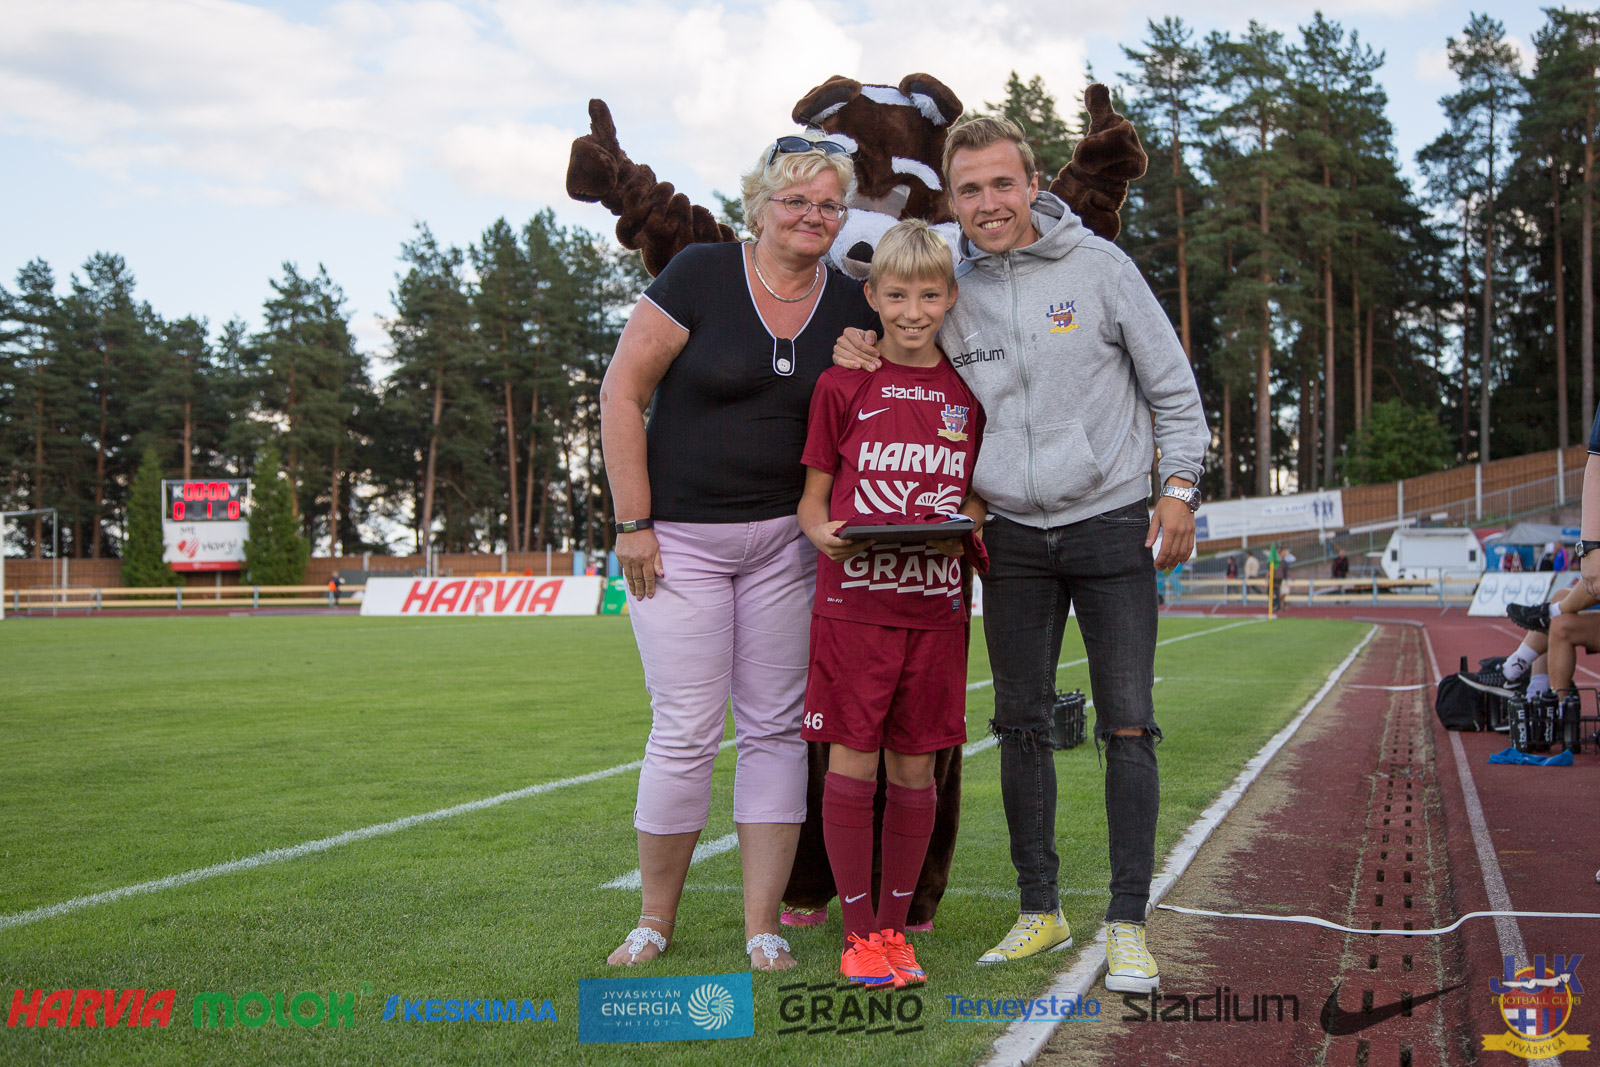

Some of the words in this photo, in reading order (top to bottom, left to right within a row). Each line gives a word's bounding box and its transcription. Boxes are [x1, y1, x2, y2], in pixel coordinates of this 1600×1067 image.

[953, 348, 1005, 368] stadium
[881, 384, 946, 403] stadium
[858, 441, 967, 479] HARVIA
[183, 482, 230, 501] 00:00
[173, 501, 186, 521] 0
[227, 500, 240, 520] 0
[843, 551, 961, 587] GRANO
[400, 579, 564, 613] HARVIA
[803, 711, 824, 731] 46
